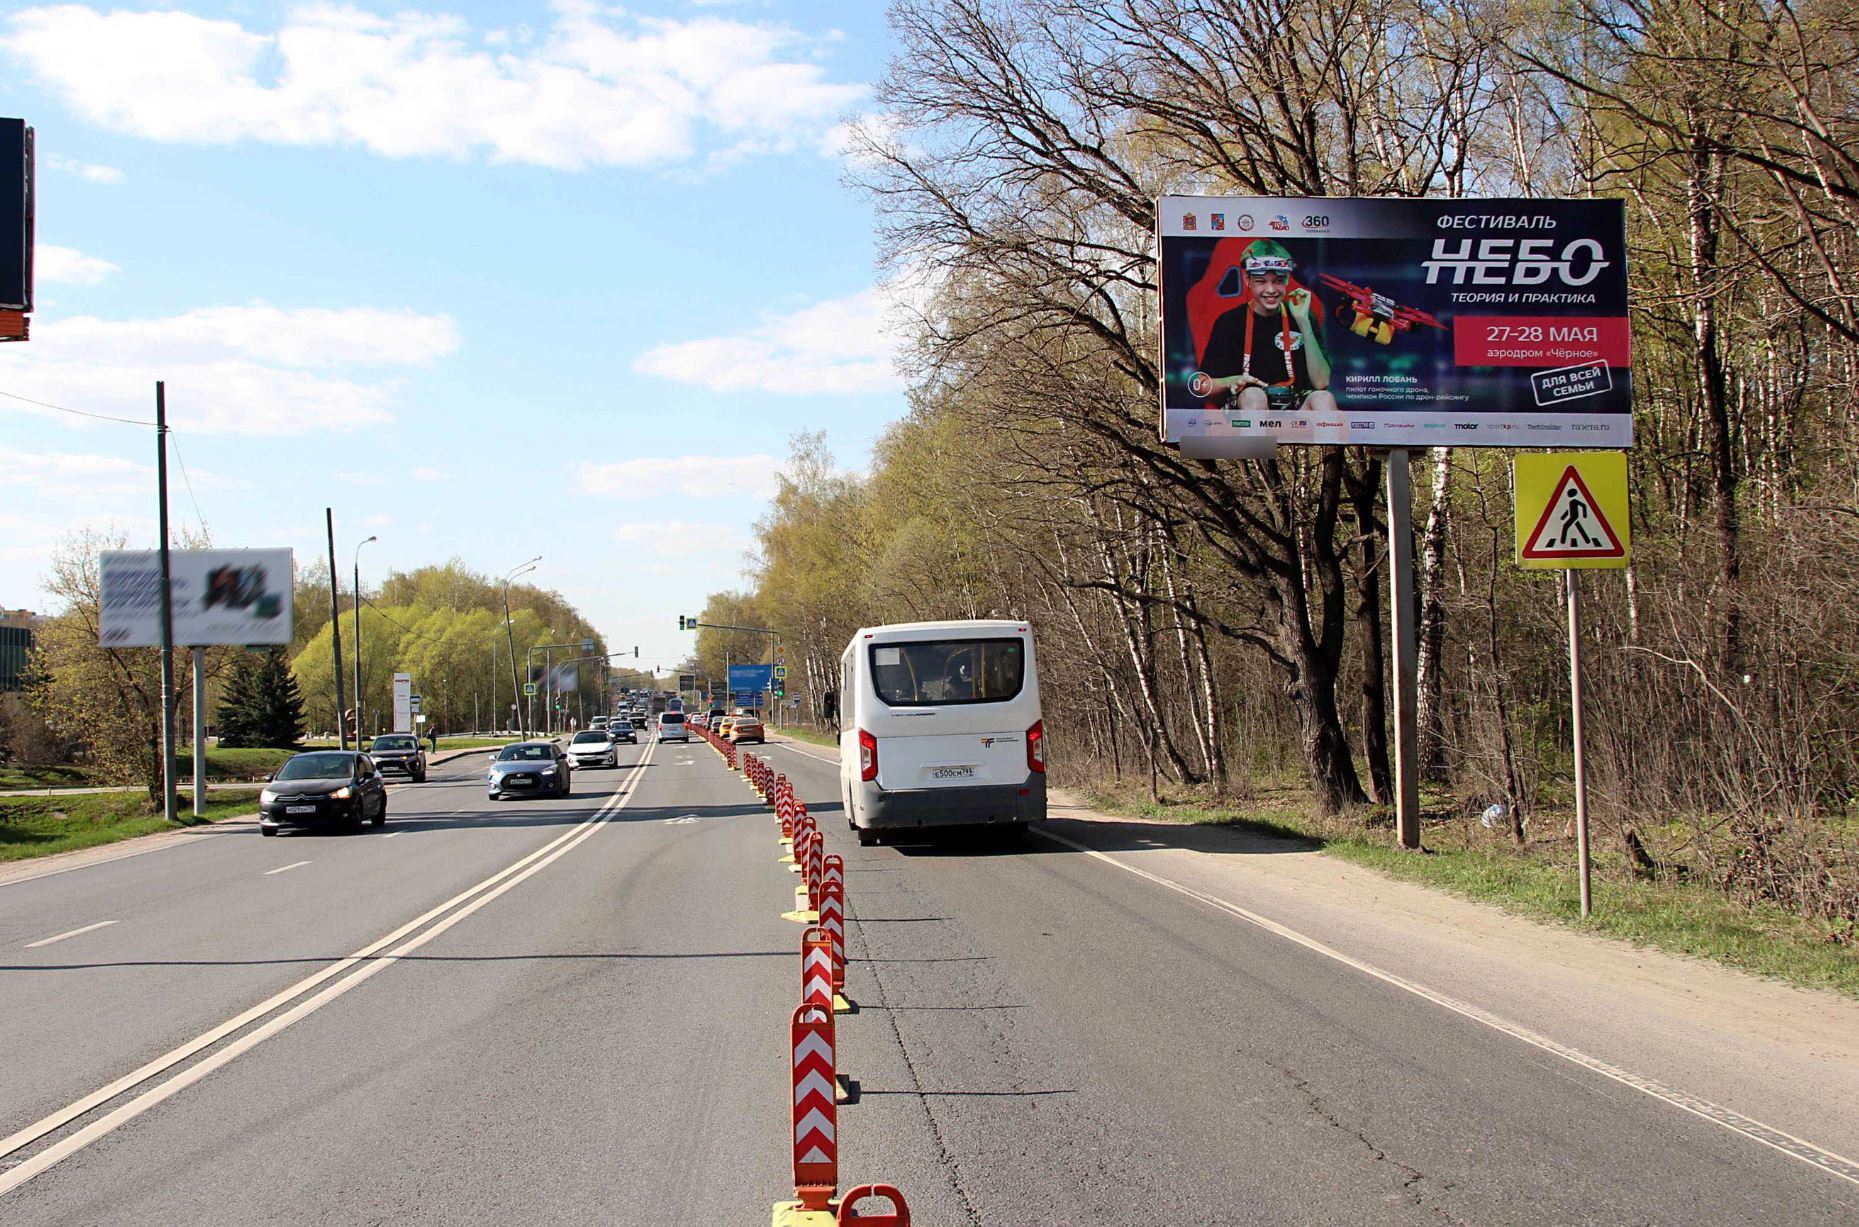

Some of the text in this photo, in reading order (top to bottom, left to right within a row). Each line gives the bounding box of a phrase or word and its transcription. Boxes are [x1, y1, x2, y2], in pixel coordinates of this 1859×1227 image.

[1305, 215, 1329, 227] 360
[1437, 215, 1557, 229] ФЕСТИВАЛЬ
[1421, 238, 1610, 287] НЕБО
[1451, 292, 1596, 304] ТЕОРИЯ И ПРАКТИКА
[1550, 327, 1598, 342] МАЯ
[1487, 348, 1598, 359] аэродром «Чёрное»
[1382, 376, 1418, 384] ЛОБАНЬ
[1541, 366, 1601, 389] ДЛЯ ВСЕЙ
[1192, 378, 1208, 391] 0+
[1553, 380, 1595, 397] СЕМЬИ
[1260, 420, 1281, 428] мел
